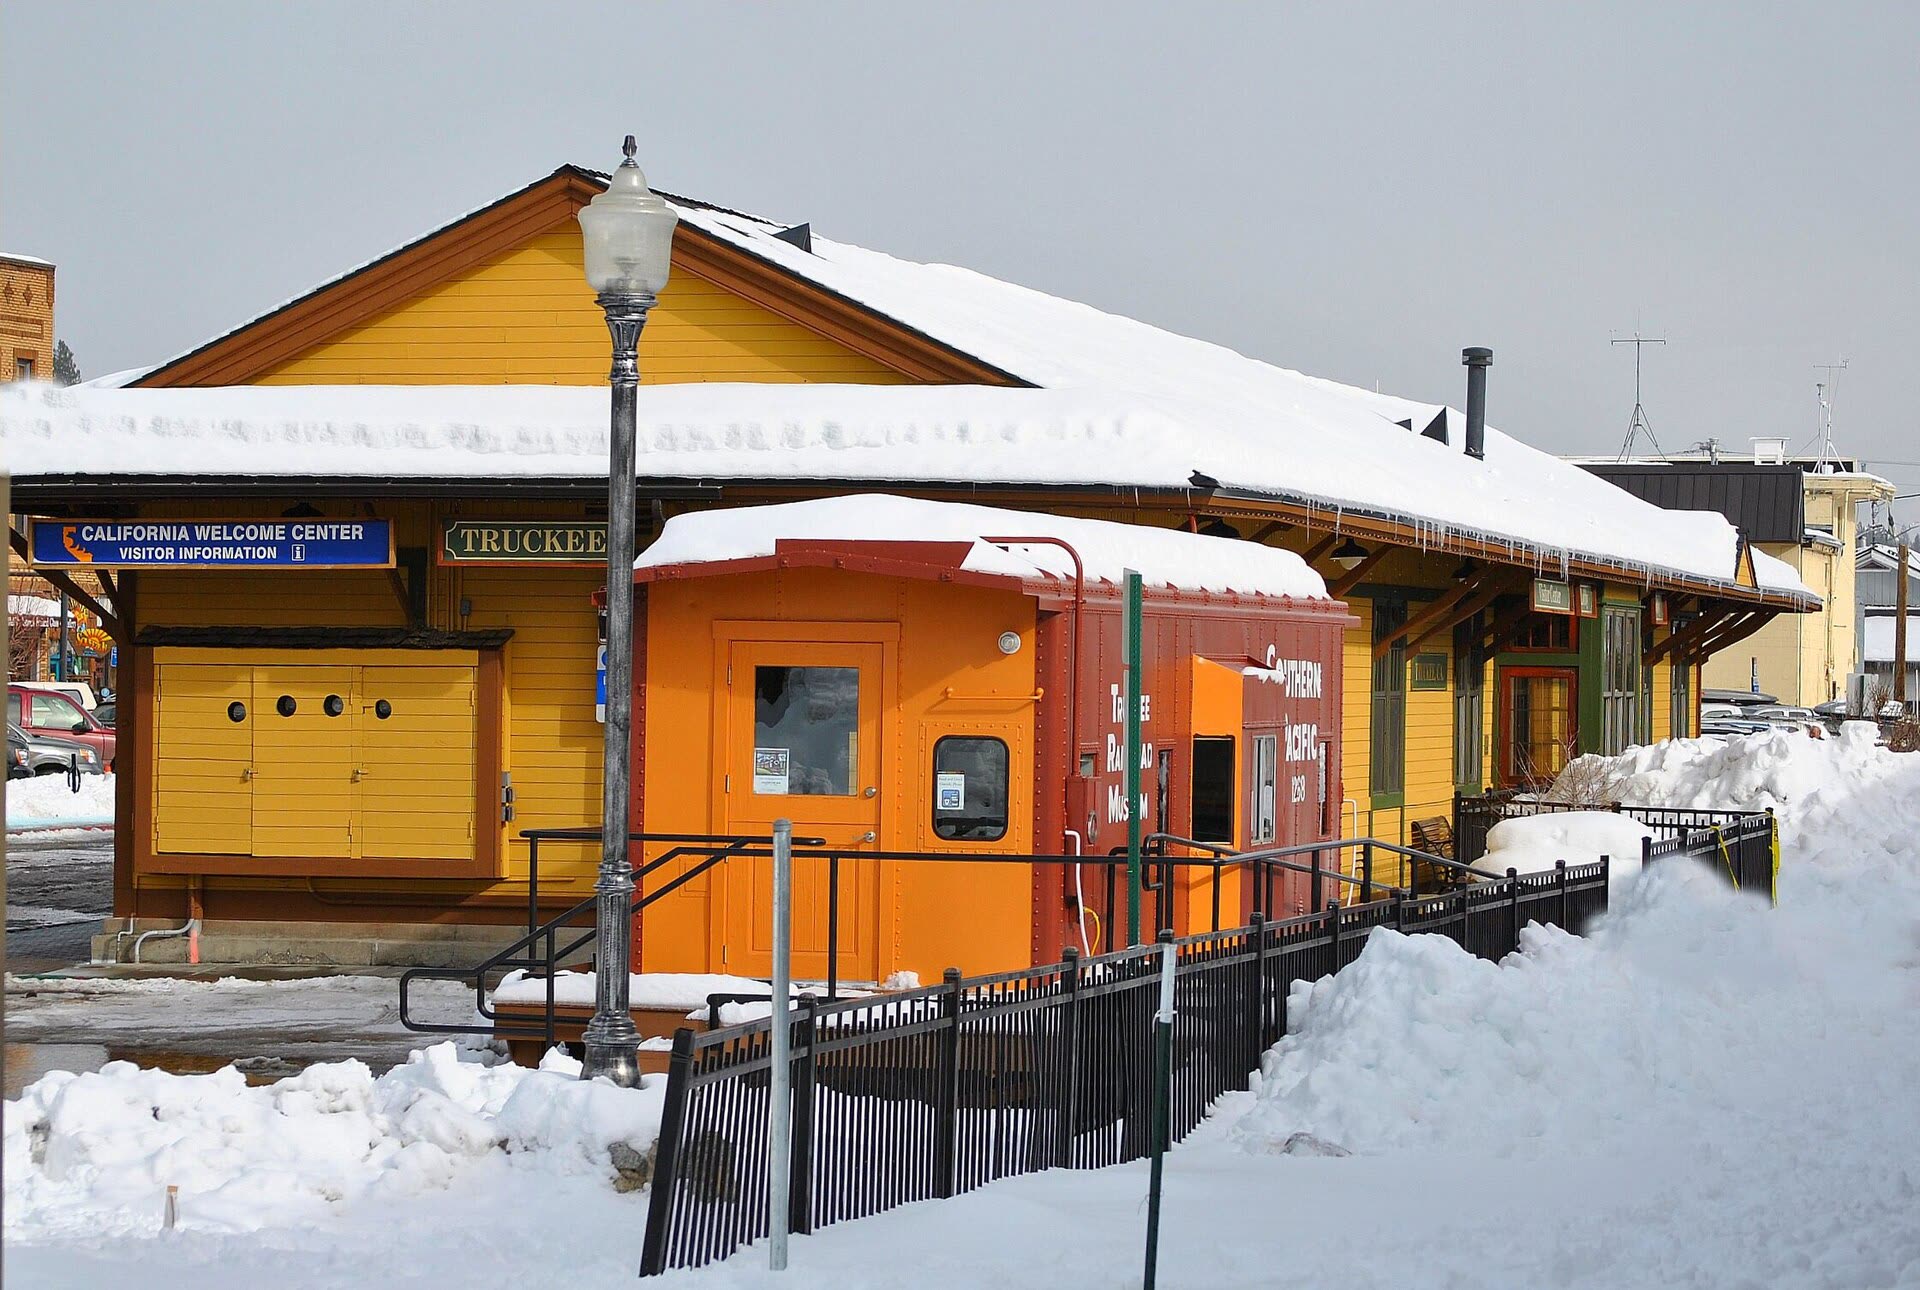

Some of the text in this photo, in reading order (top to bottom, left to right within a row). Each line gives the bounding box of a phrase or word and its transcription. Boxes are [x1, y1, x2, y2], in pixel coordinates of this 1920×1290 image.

[82, 524, 364, 541] CALIFORNIA WELCOME CENTER
[460, 528, 606, 553] TRUCKEE
[119, 547, 175, 560] VISITOR
[179, 546, 277, 560] INFORMATION
[1110, 683, 1150, 724] TREE
[1107, 733, 1153, 773] RAIAD
[1284, 713, 1318, 762] ACIFIC
[1108, 784, 1148, 824] MUSM
